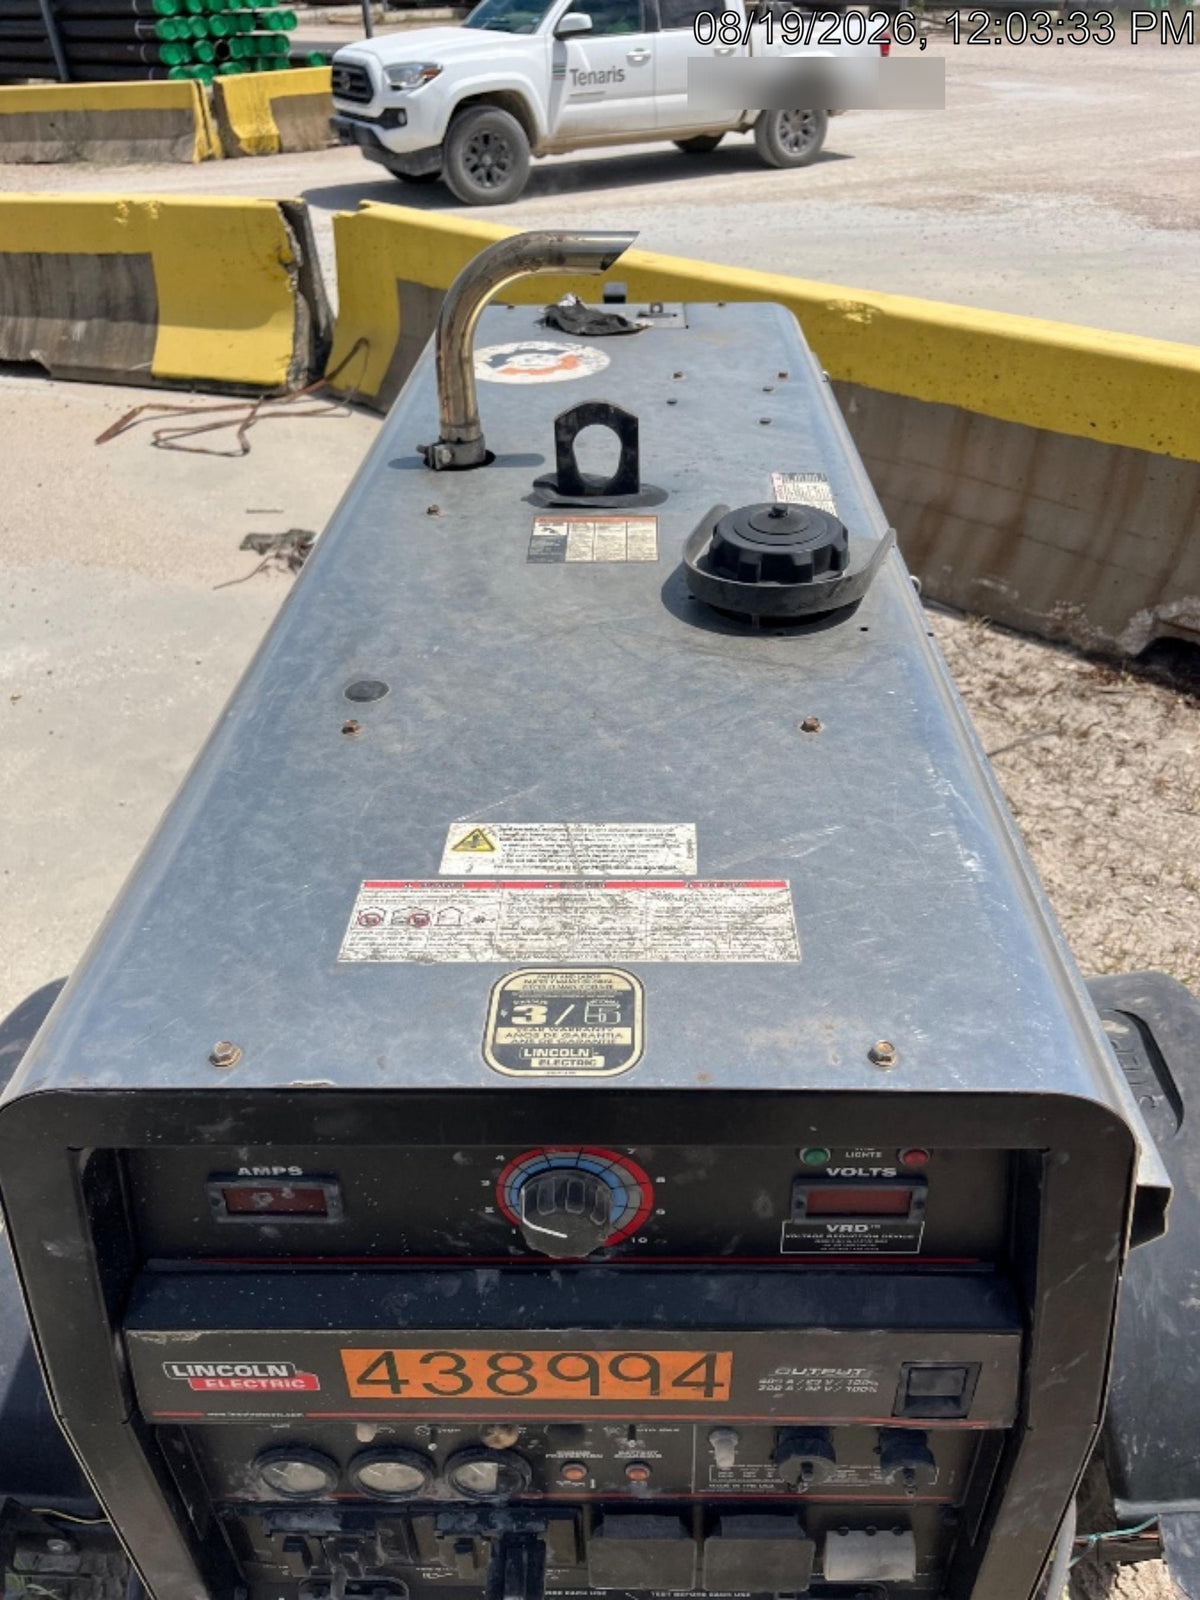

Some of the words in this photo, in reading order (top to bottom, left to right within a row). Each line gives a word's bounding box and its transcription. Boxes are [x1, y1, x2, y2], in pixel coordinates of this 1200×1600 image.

[569, 66, 625, 86] Tenaris
[511, 1005, 548, 1024] 3
[523, 1048, 590, 1057] LINCOLN
[237, 1166, 303, 1176] AMPS
[826, 1167, 897, 1178] VOLTS
[631, 1236, 648, 1244] 10
[172, 1364, 289, 1377] LINCOLN
[356, 1350, 724, 1398] 438994
[774, 1367, 866, 1376] OUTPUT
[204, 1378, 306, 1388] ELECTRIC
